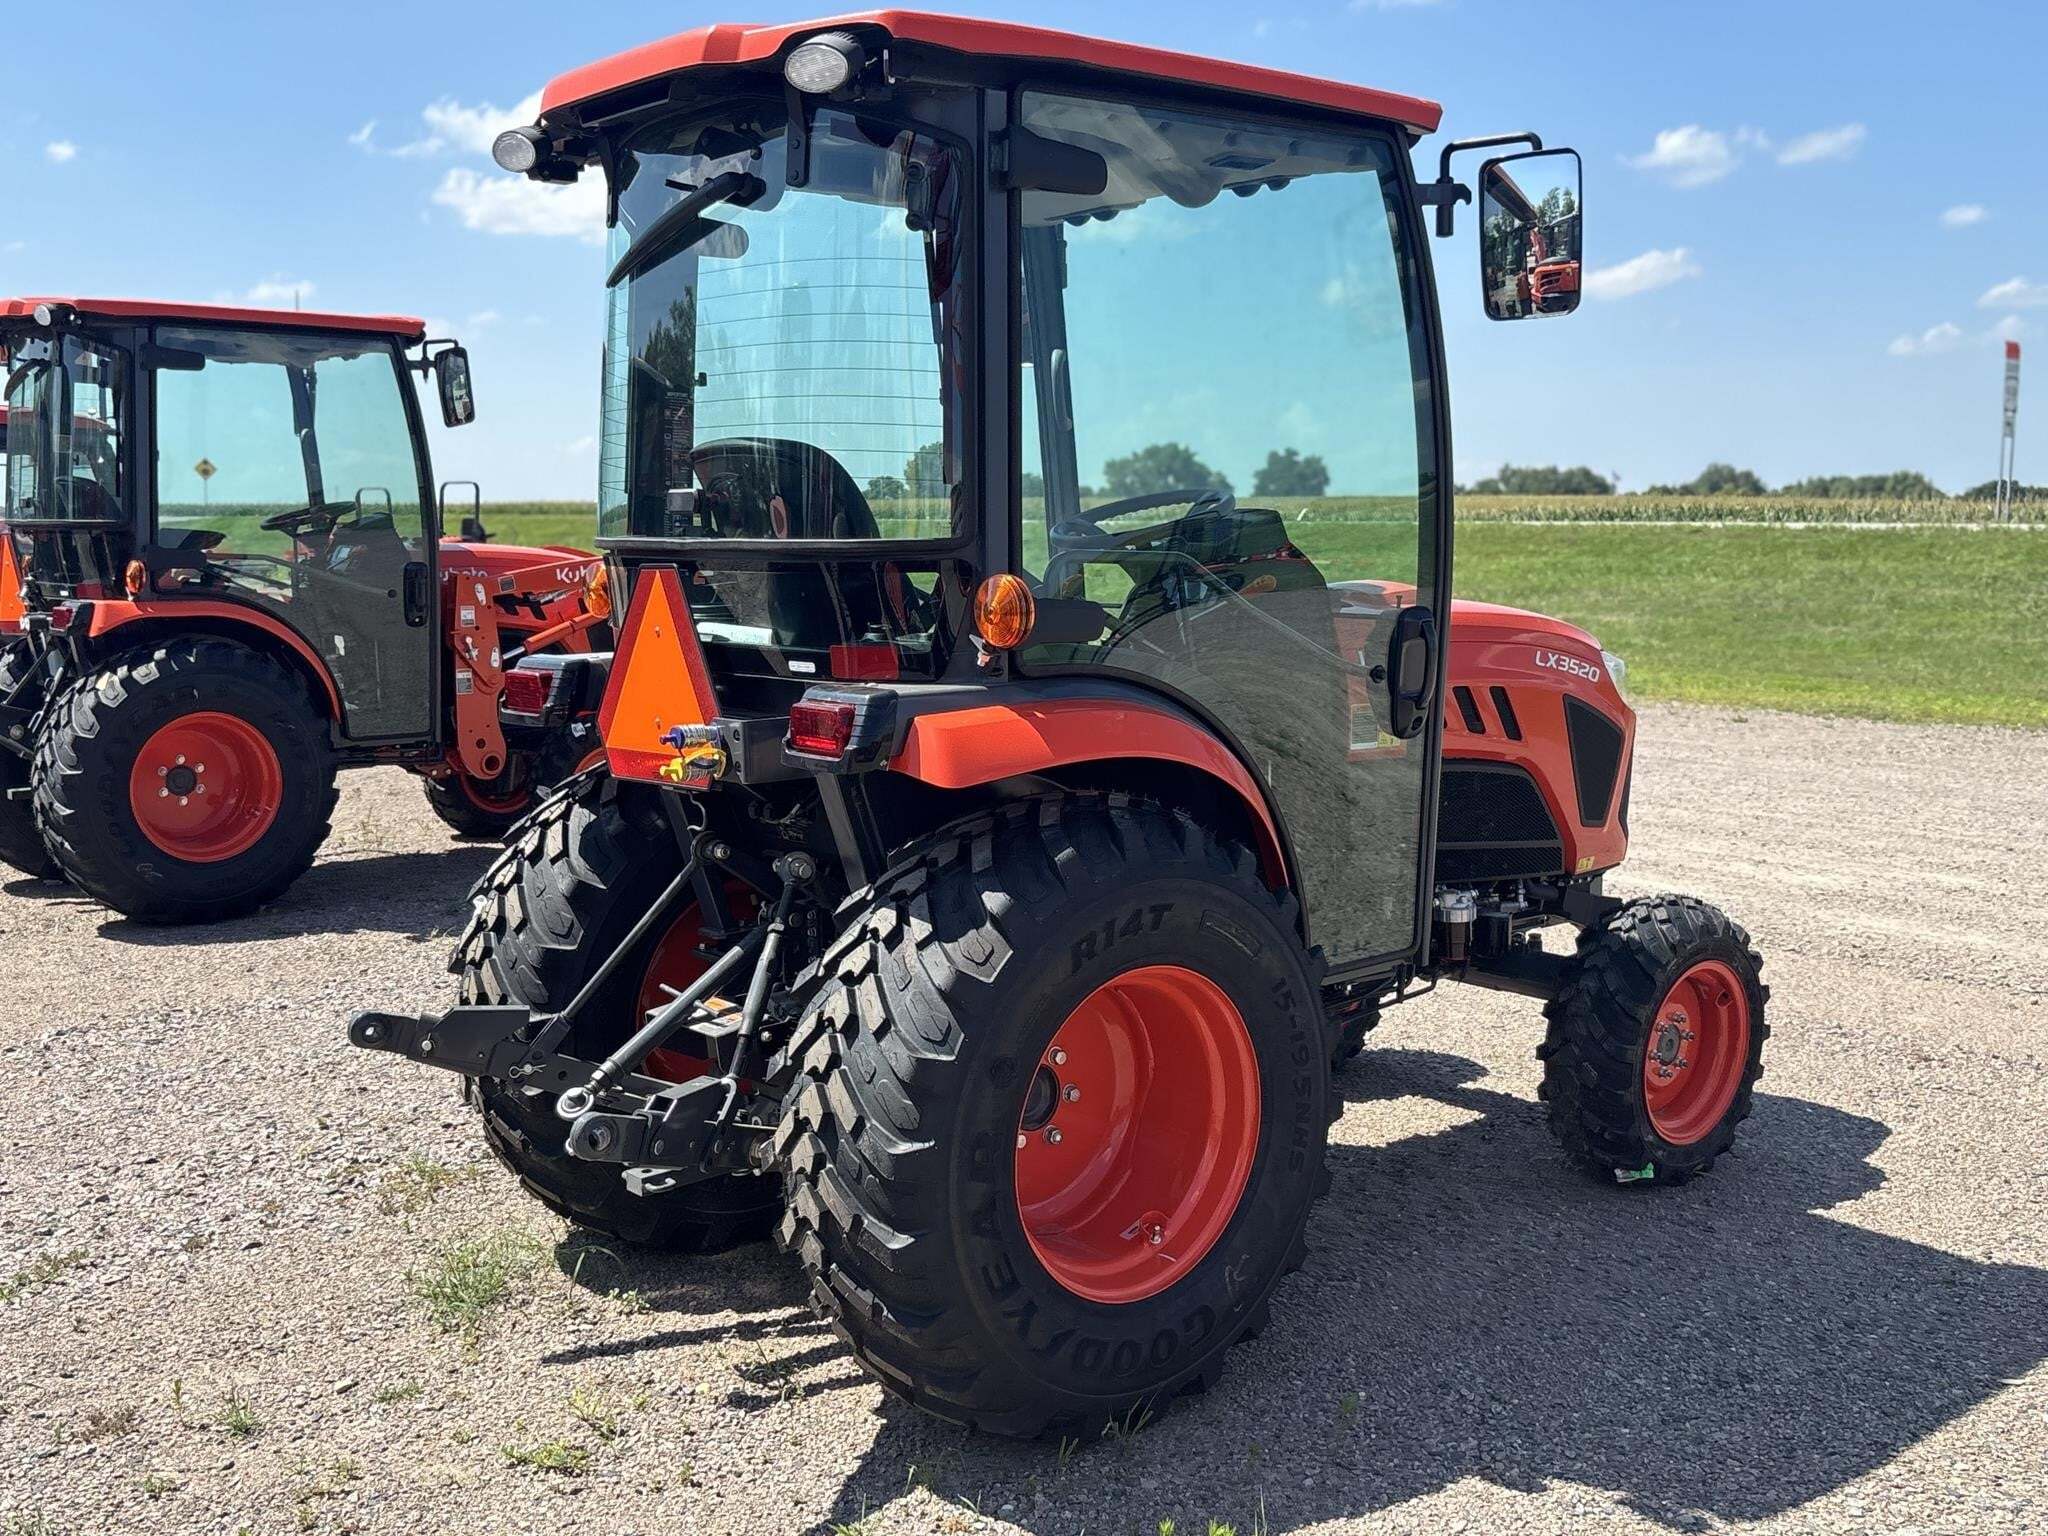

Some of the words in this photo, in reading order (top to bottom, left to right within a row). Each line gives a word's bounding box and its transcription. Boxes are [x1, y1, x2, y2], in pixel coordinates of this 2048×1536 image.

[1535, 650, 1600, 683] LX3520
[1070, 903, 1174, 974] R14T
[968, 1130, 1218, 1377] GOODYEAR
